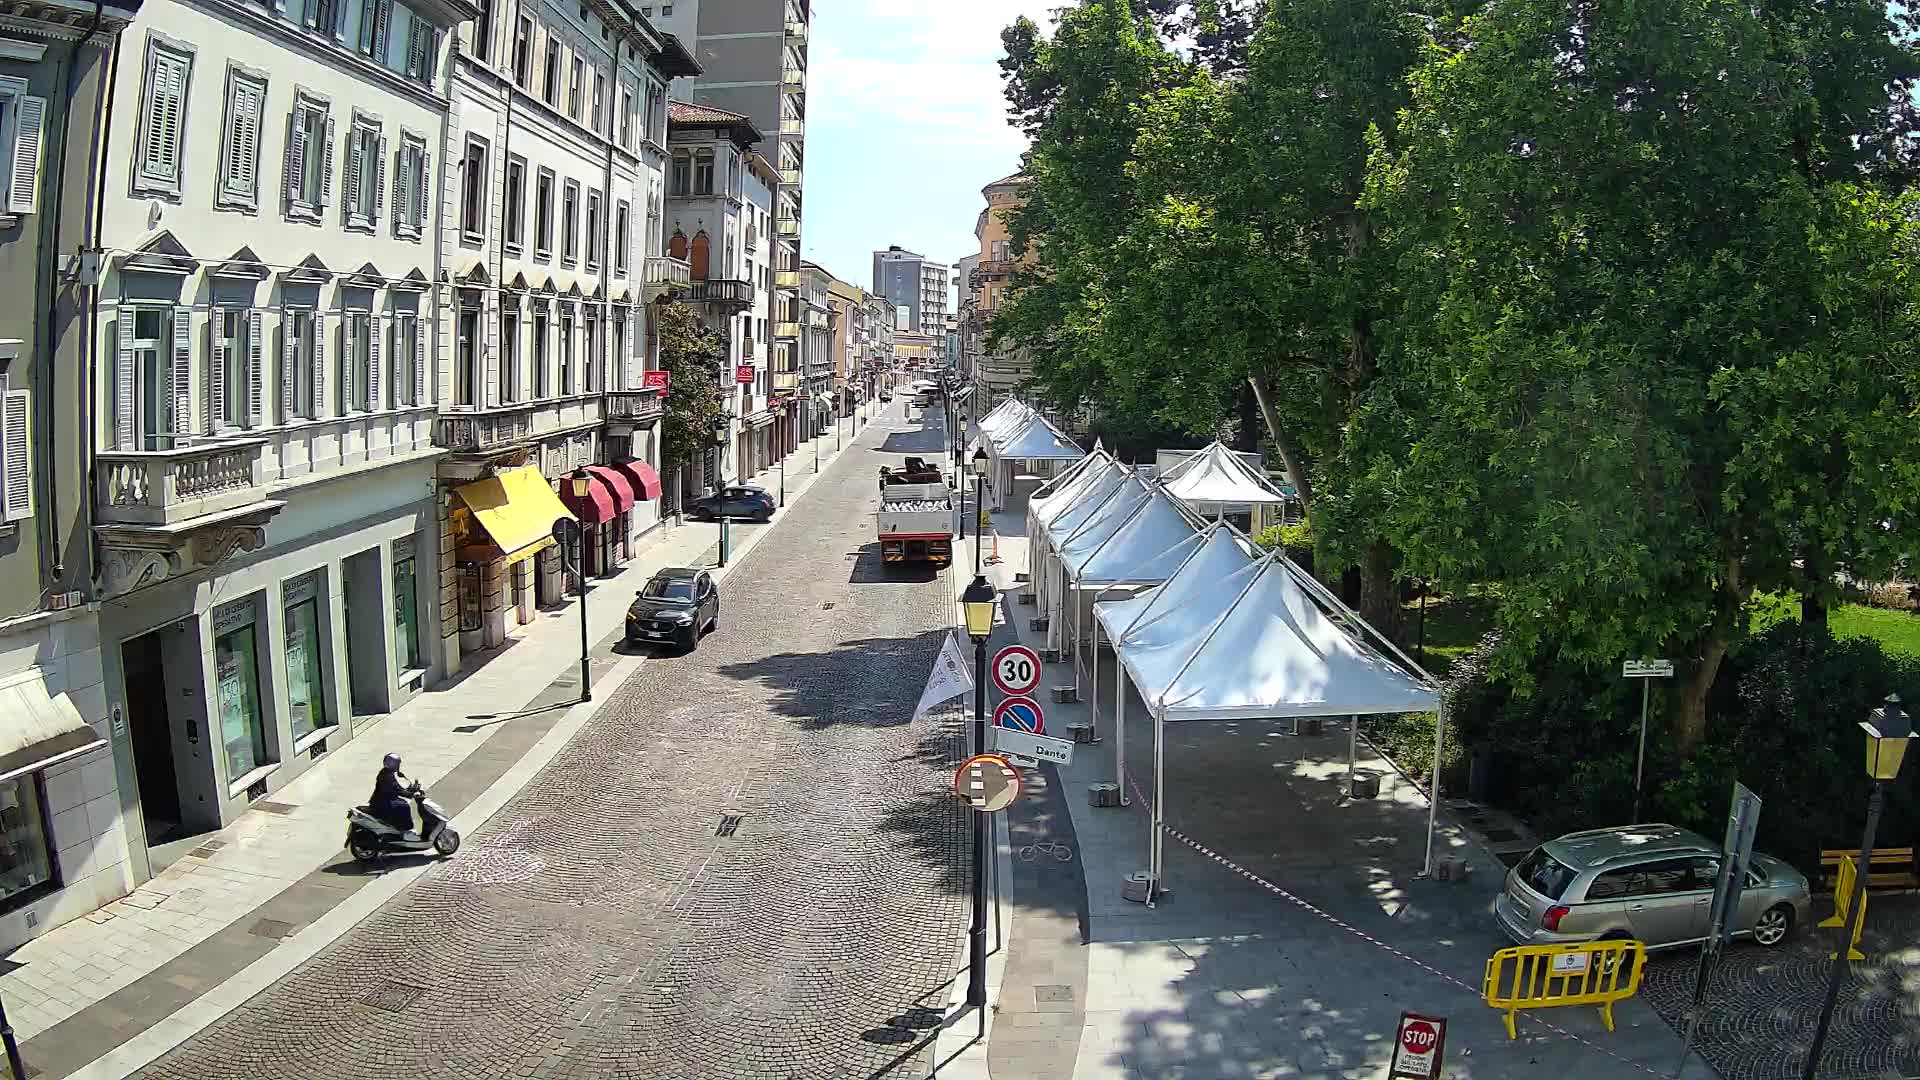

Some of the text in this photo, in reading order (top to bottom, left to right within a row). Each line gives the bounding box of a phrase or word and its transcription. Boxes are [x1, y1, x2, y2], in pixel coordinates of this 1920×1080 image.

[1003, 659, 1032, 682] 30
[1035, 746, 1067, 760] Dante
[1404, 1030, 1435, 1046] STOP
